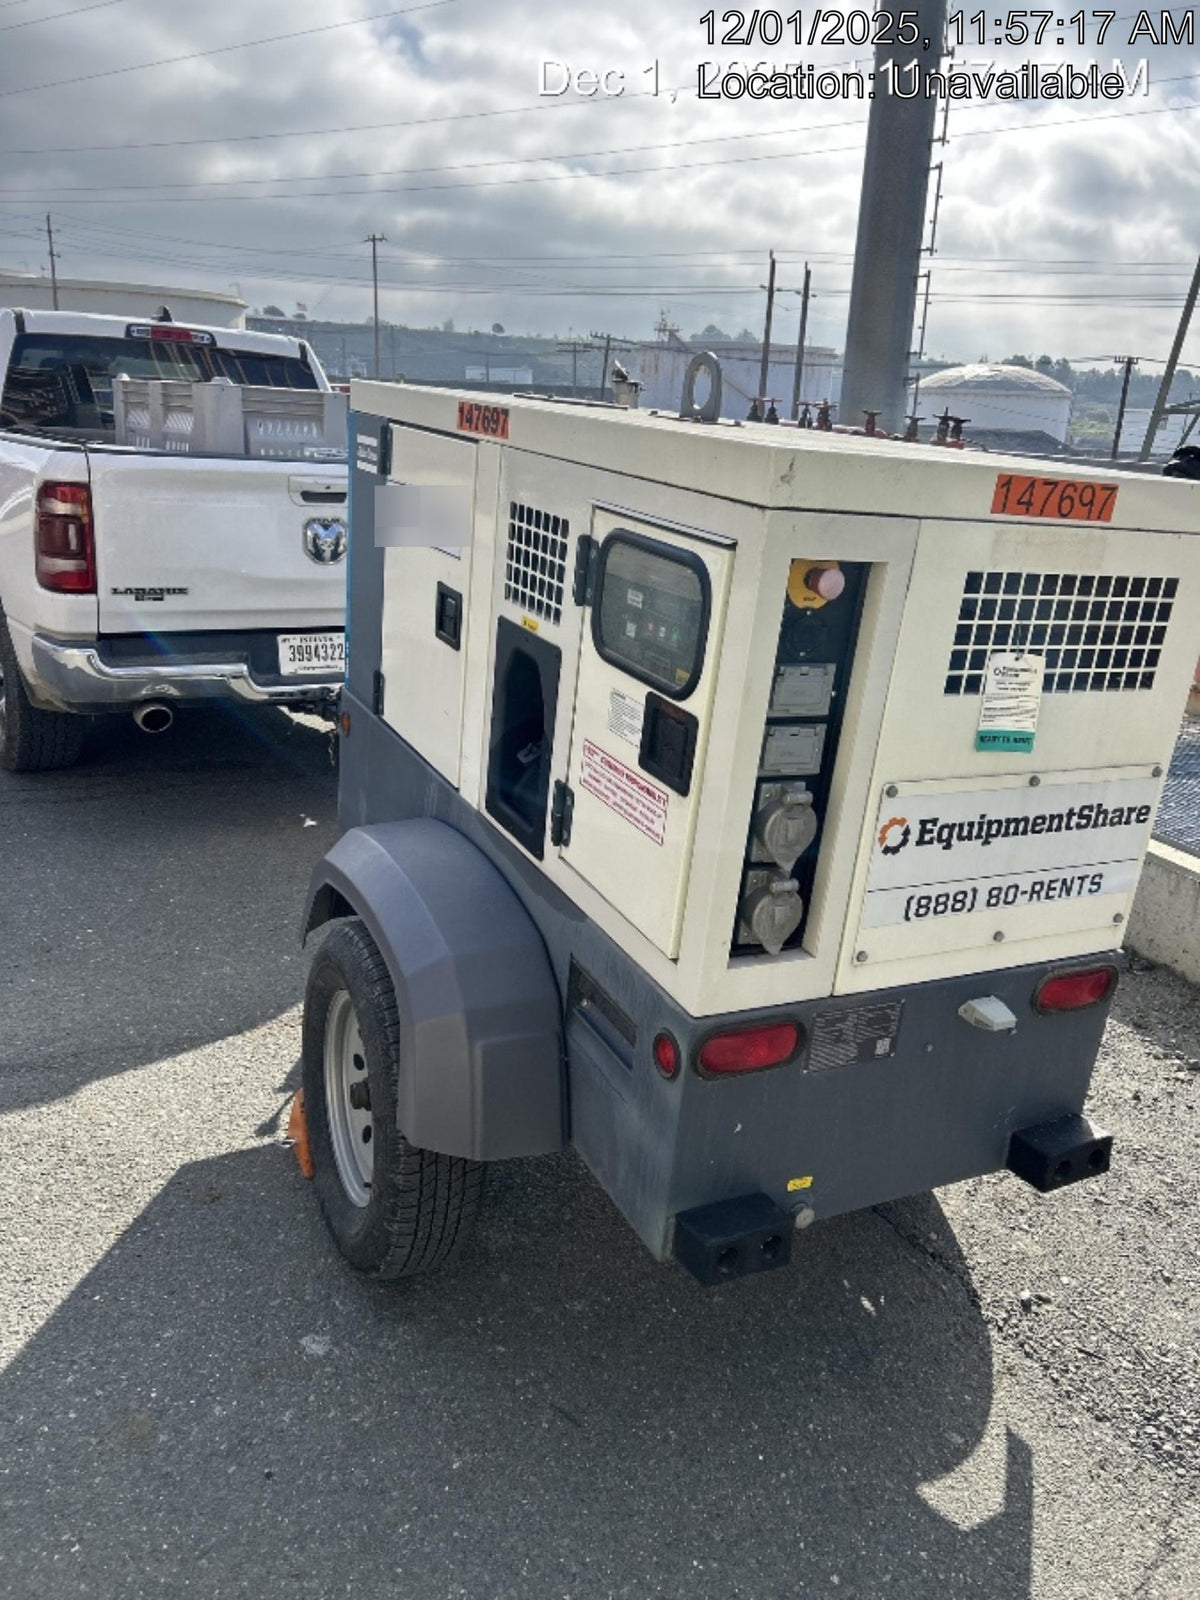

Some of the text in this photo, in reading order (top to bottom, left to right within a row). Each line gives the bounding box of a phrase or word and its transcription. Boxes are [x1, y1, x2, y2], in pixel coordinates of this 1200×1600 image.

[458, 401, 510, 437] 147697
[1000, 475, 1119, 520] 147697
[915, 803, 1151, 850] EquipmentShare
[903, 873, 1104, 922] (888) 80-RENTS
